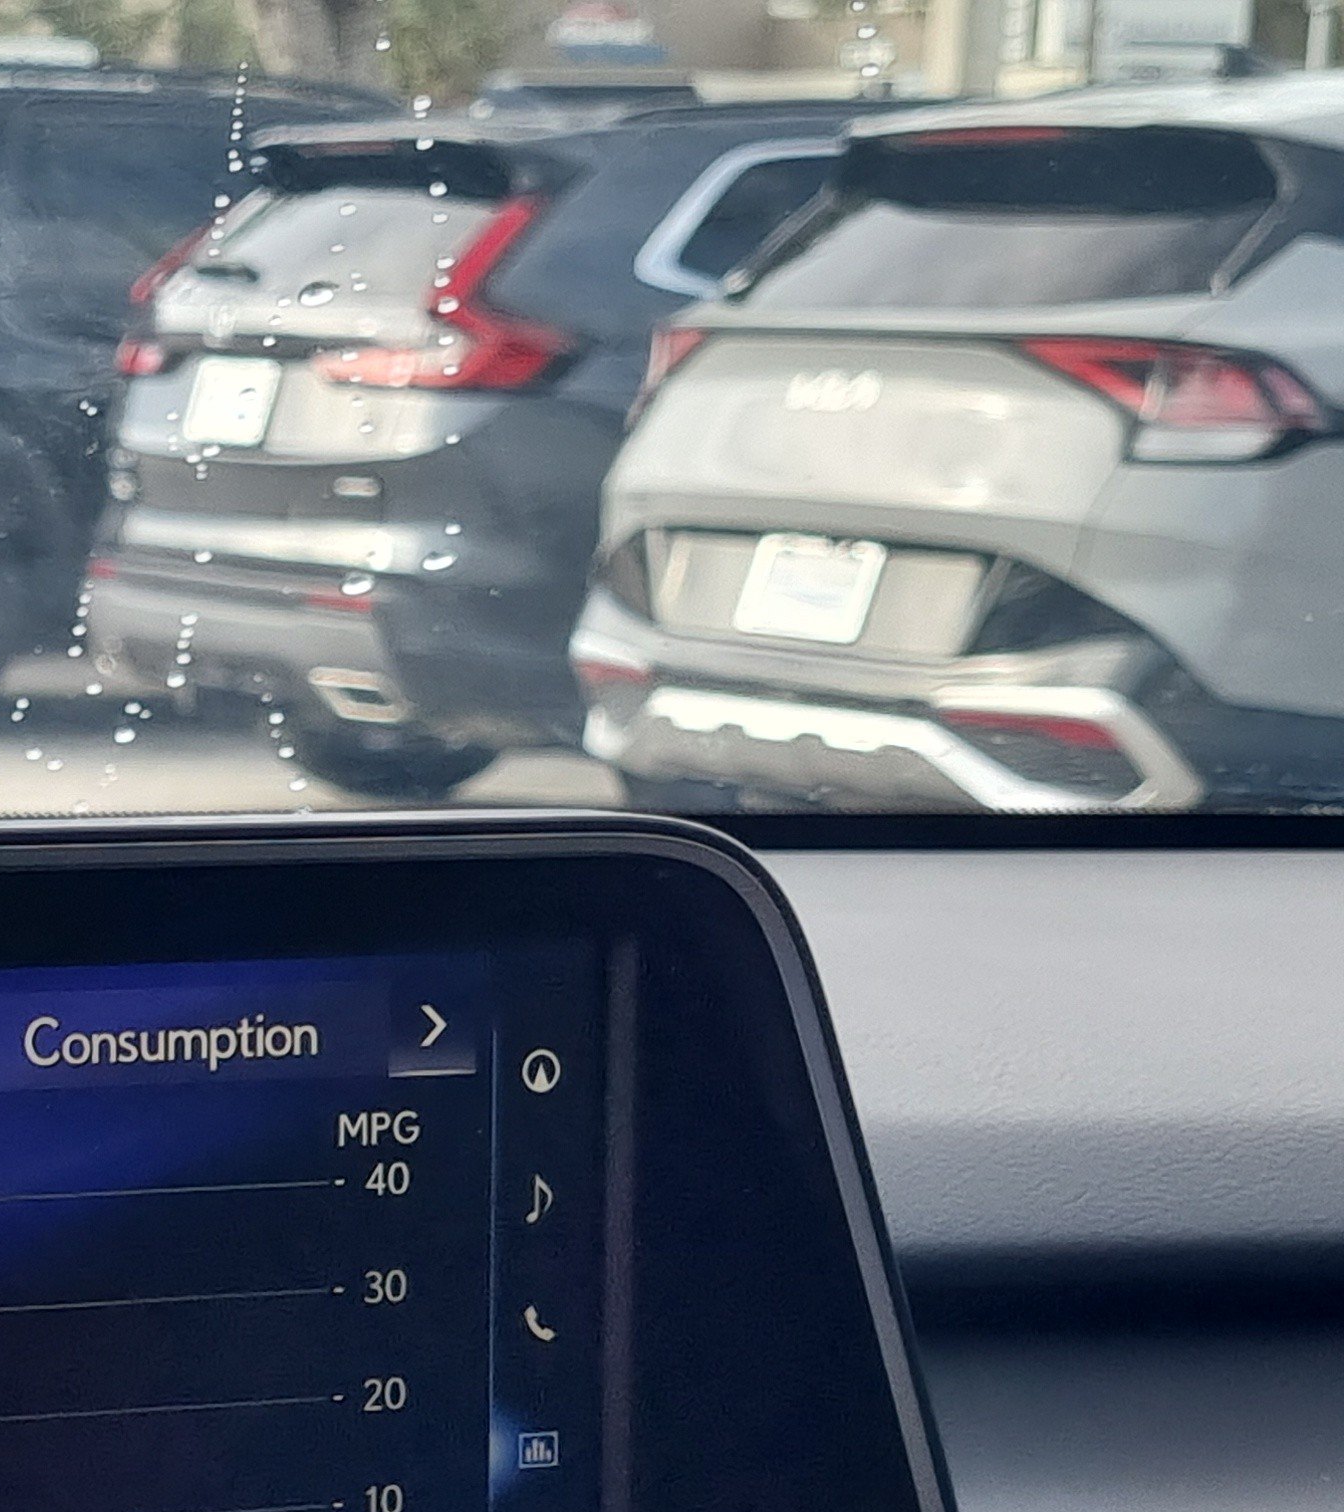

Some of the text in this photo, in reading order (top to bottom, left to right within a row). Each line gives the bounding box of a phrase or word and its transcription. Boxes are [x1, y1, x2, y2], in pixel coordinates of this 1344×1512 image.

[23, 1013, 318, 1073] Consumption
[337, 1111, 421, 1148] MPG
[364, 1161, 411, 1198] 40
[362, 1269, 408, 1305] 30
[362, 1376, 407, 1414] 20
